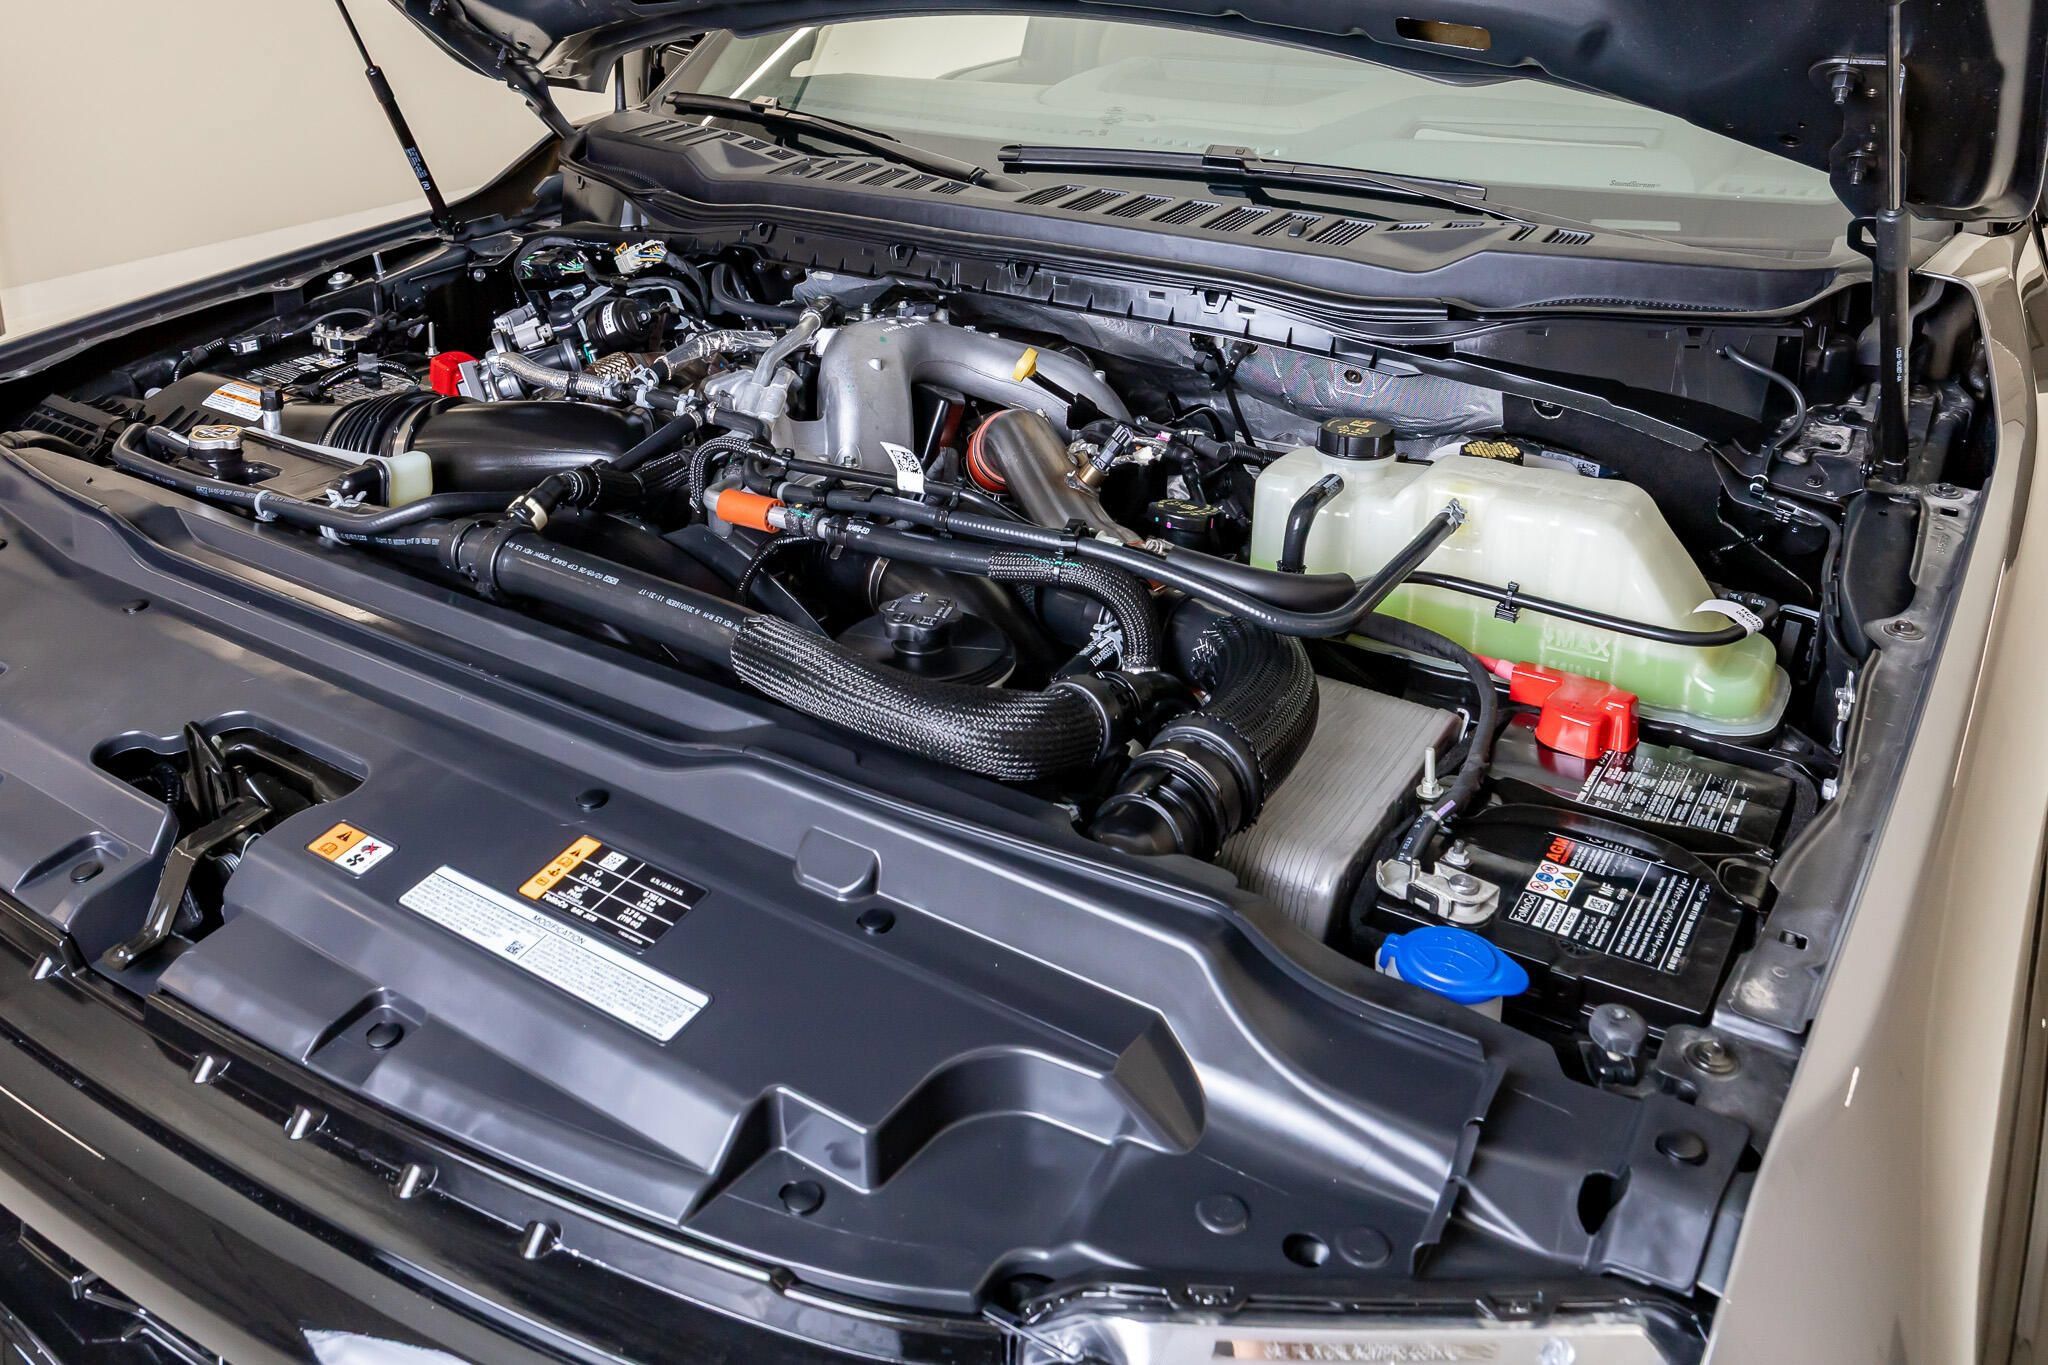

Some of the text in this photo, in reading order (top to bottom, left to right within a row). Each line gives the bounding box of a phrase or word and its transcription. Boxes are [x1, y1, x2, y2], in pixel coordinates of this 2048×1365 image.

[1609, 178, 1657, 189] SoundScreen
[693, 607, 701, 615] A
[713, 614, 723, 623] LS
[1553, 629, 1610, 658] MAX
[1544, 836, 1569, 862] AGM
[1597, 881, 1616, 897] MF
[1512, 892, 1538, 923] FoMoCo
[533, 914, 586, 945] MODIFICATION
